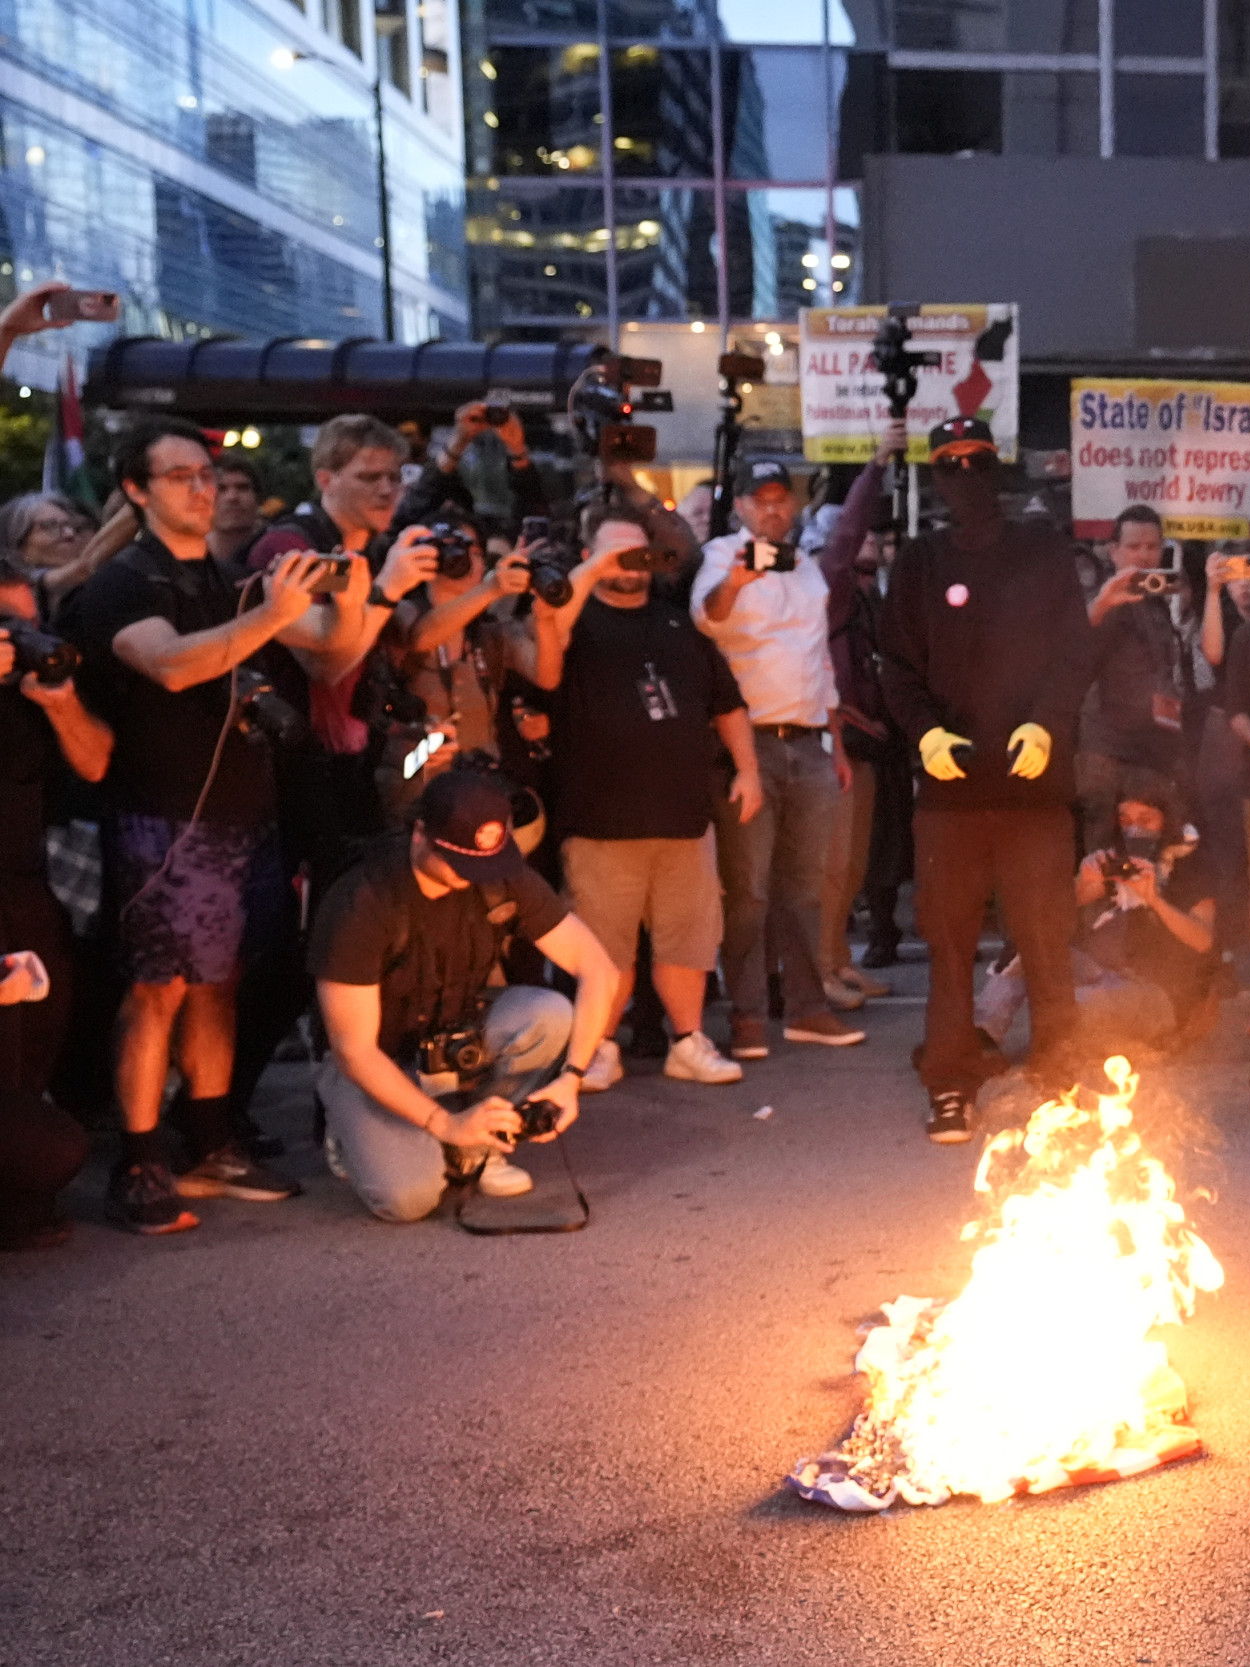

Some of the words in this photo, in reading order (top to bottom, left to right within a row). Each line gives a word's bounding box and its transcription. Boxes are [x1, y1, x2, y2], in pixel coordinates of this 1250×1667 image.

[827, 316, 878, 333] Torah
[807, 353, 842, 375] ALL
[1080, 391, 1149, 429] State
[1158, 393, 1185, 430] of
[1079, 441, 1134, 468] does
[1138, 442, 1178, 469] not
[1125, 476, 1180, 501] world
[1187, 477, 1247, 509] Jewry
